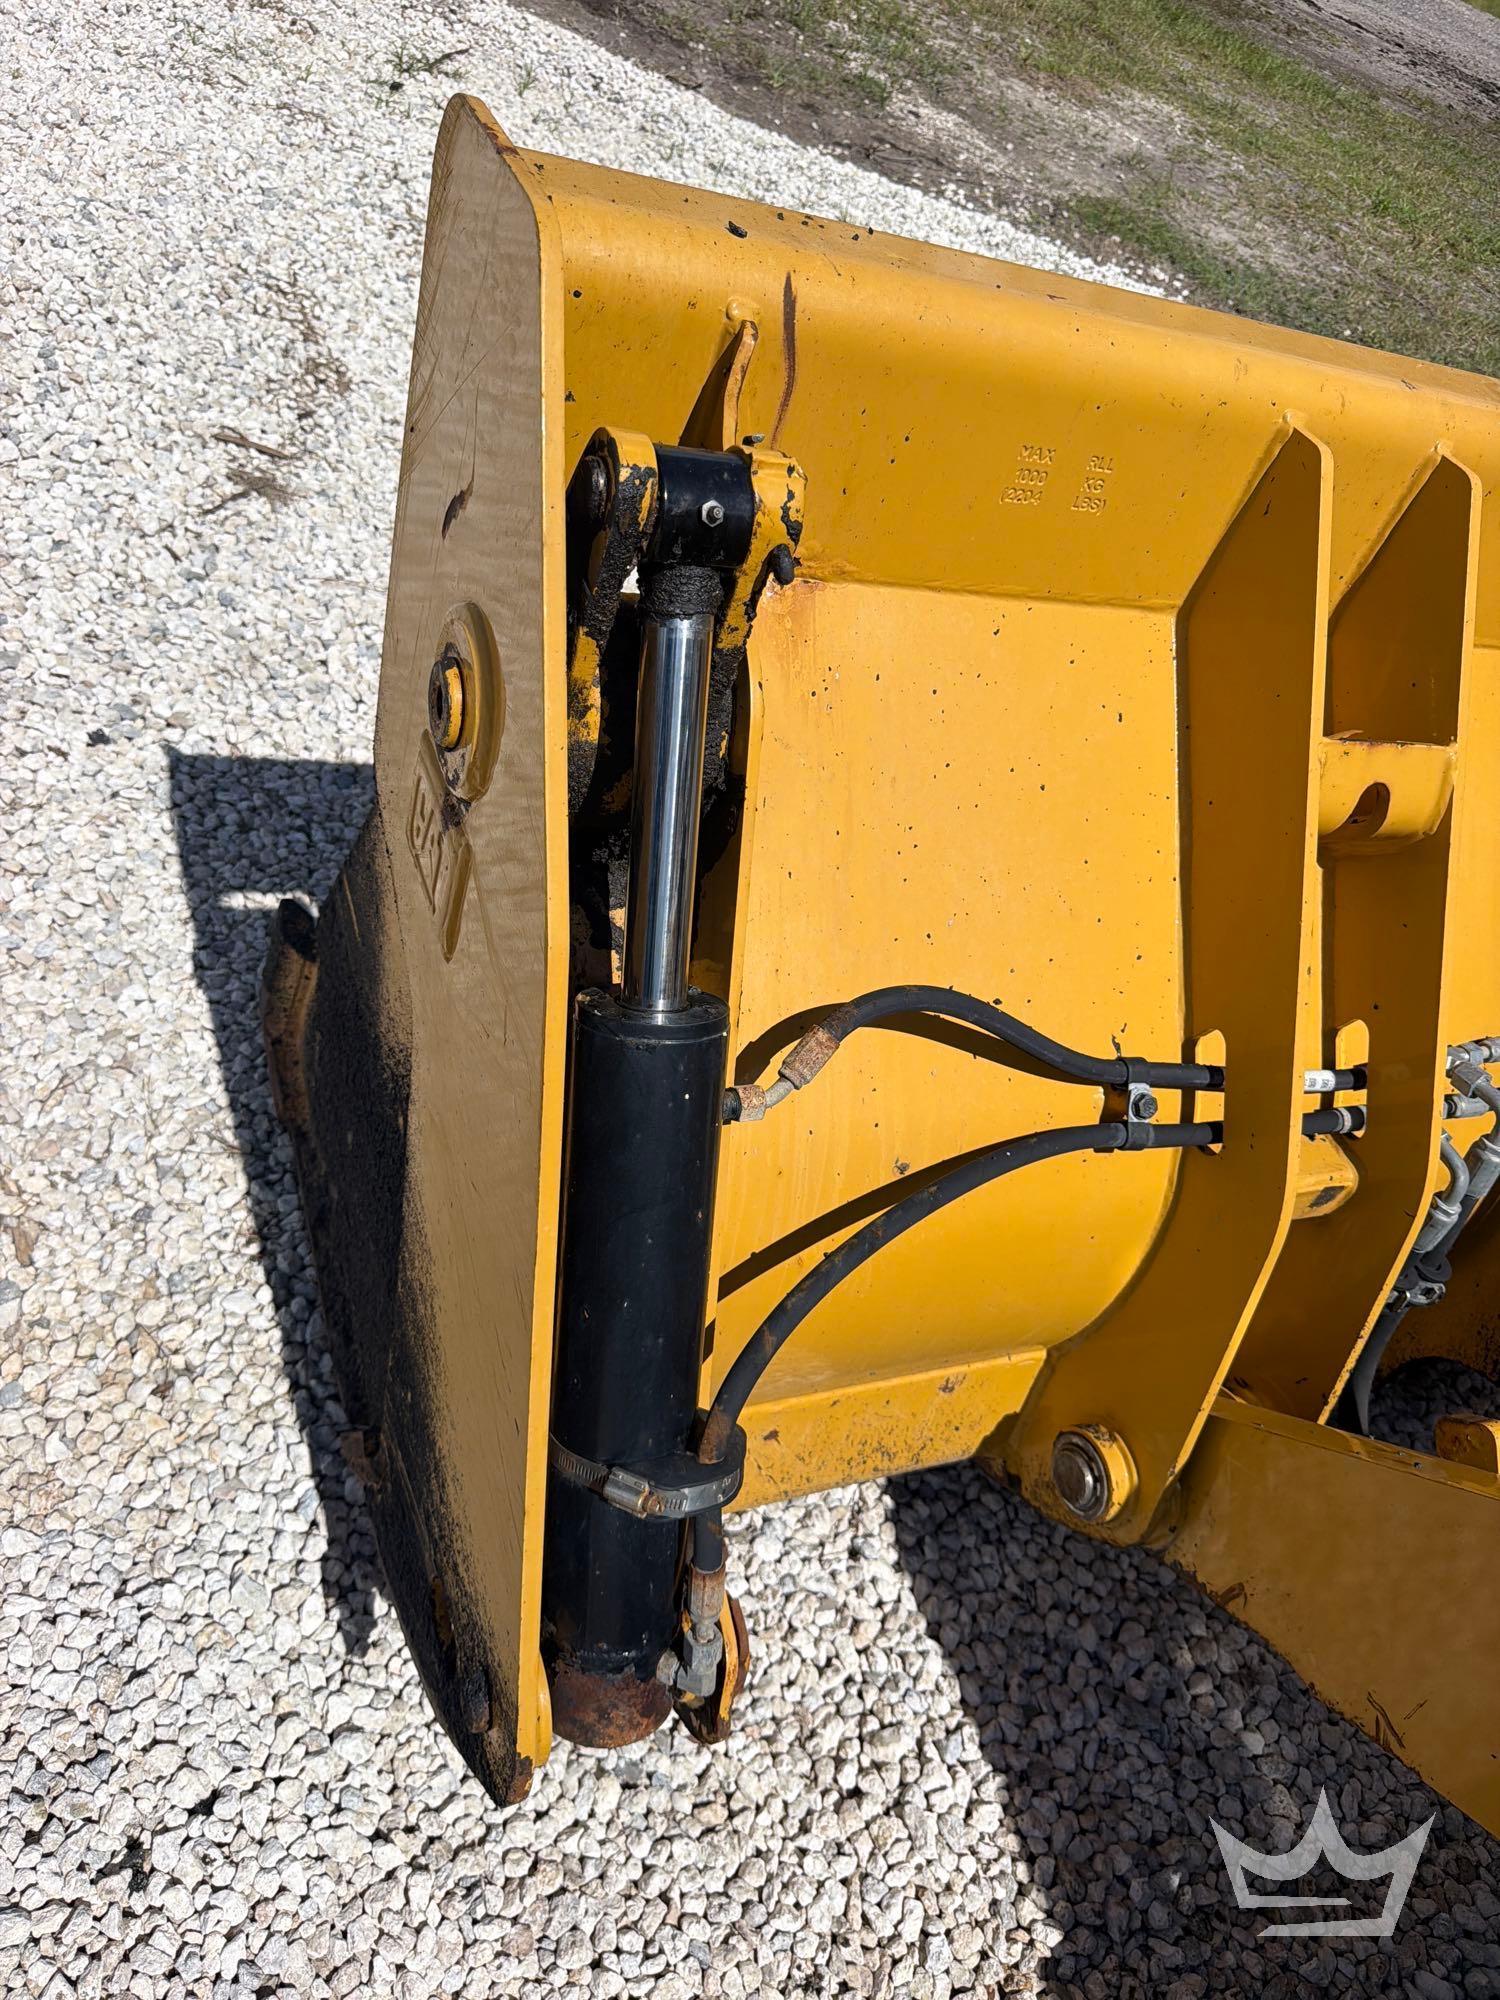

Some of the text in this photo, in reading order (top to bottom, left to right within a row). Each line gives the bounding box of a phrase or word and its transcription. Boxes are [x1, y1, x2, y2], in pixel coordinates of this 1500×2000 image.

[1017, 445, 1056, 464] MAX
[1015, 467, 1105, 493] 1000 KG
[999, 486, 1107, 516] (2204 LBS)
